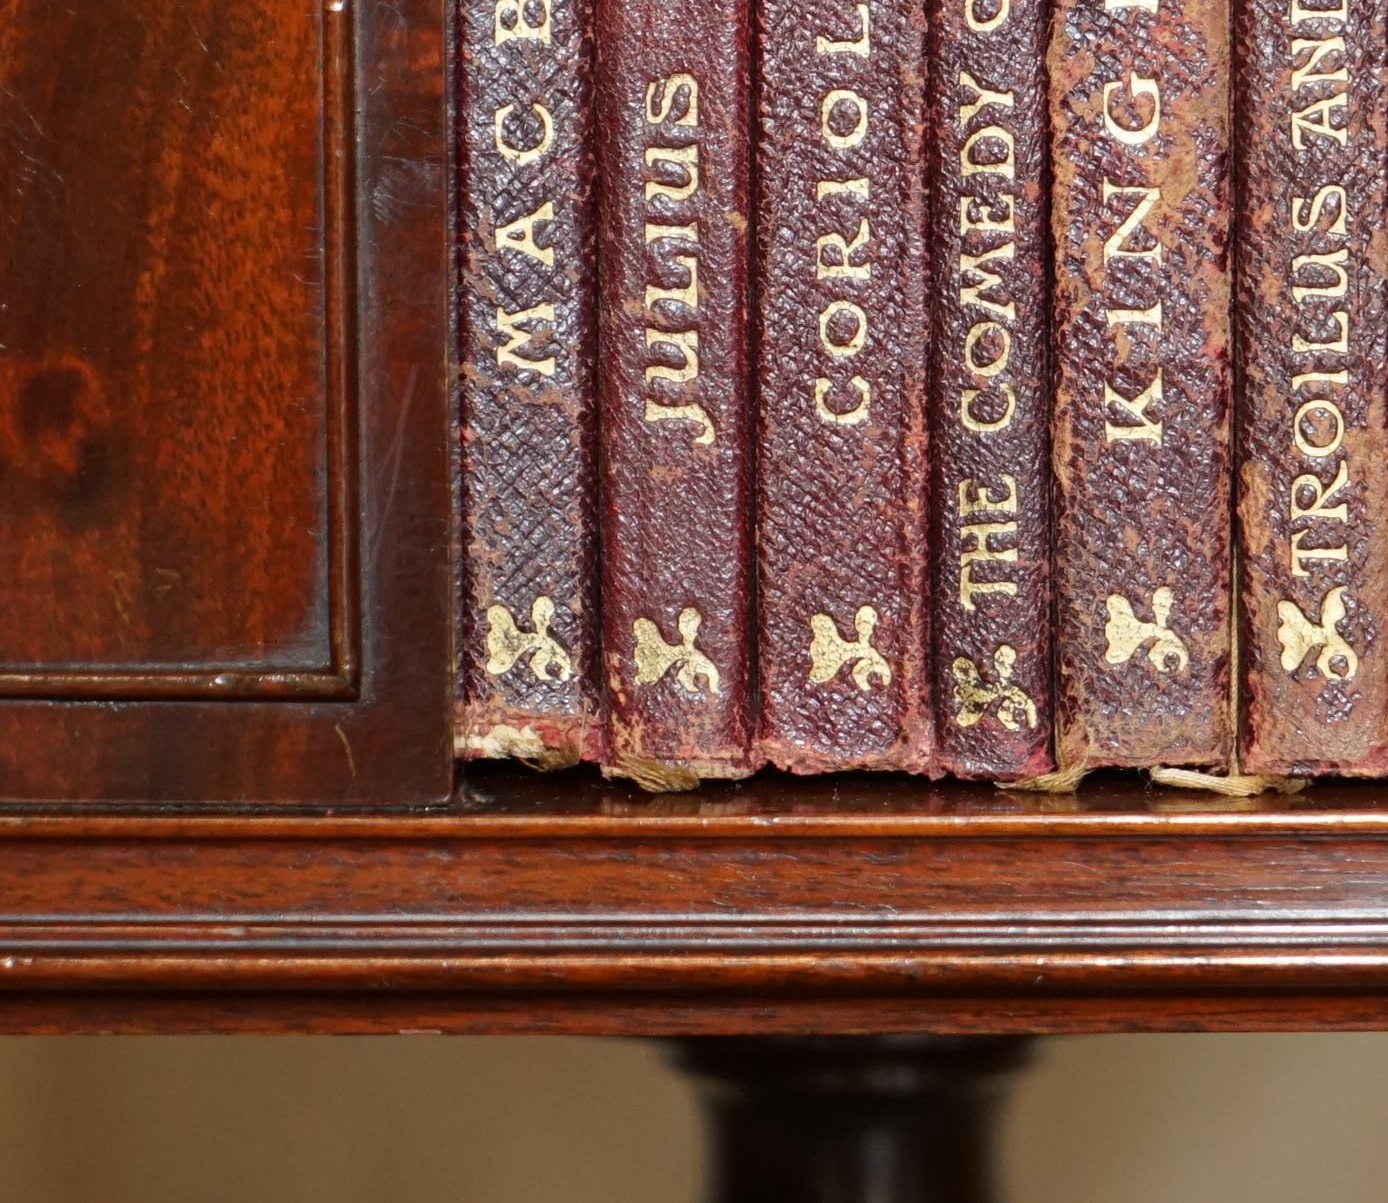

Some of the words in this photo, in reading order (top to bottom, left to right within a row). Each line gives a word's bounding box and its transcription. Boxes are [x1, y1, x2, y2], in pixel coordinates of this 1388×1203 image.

[644, 71, 714, 443] JULIUS
[959, 71, 1017, 431] COMEDY
[1104, 69, 1161, 443] KING
[1291, 181, 1349, 576] TROILUS
[959, 478, 1018, 609] THE
